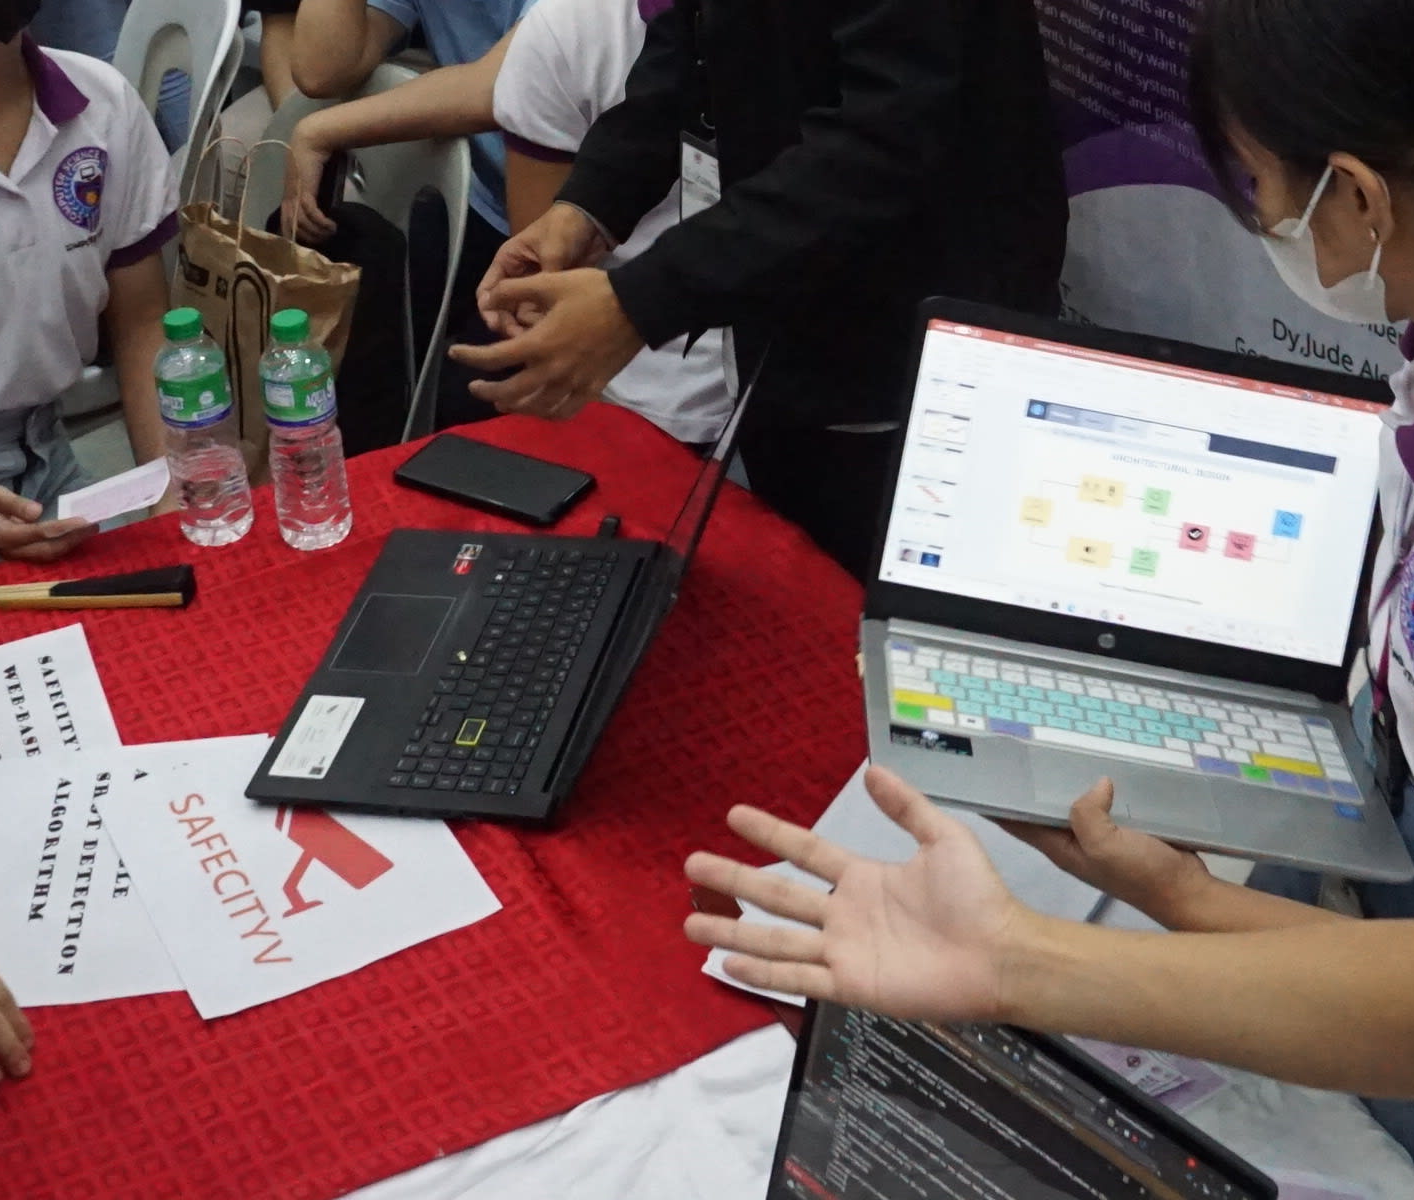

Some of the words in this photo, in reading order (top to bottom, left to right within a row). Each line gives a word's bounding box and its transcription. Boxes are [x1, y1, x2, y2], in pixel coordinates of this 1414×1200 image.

[1155, 5, 1176, 23] are
[37, 655, 82, 752] SAFECITY
[28, 777, 73, 923] ALGORITHM
[57, 839, 99, 975] DETECTION
[169, 791, 294, 966] SAFECITYV
